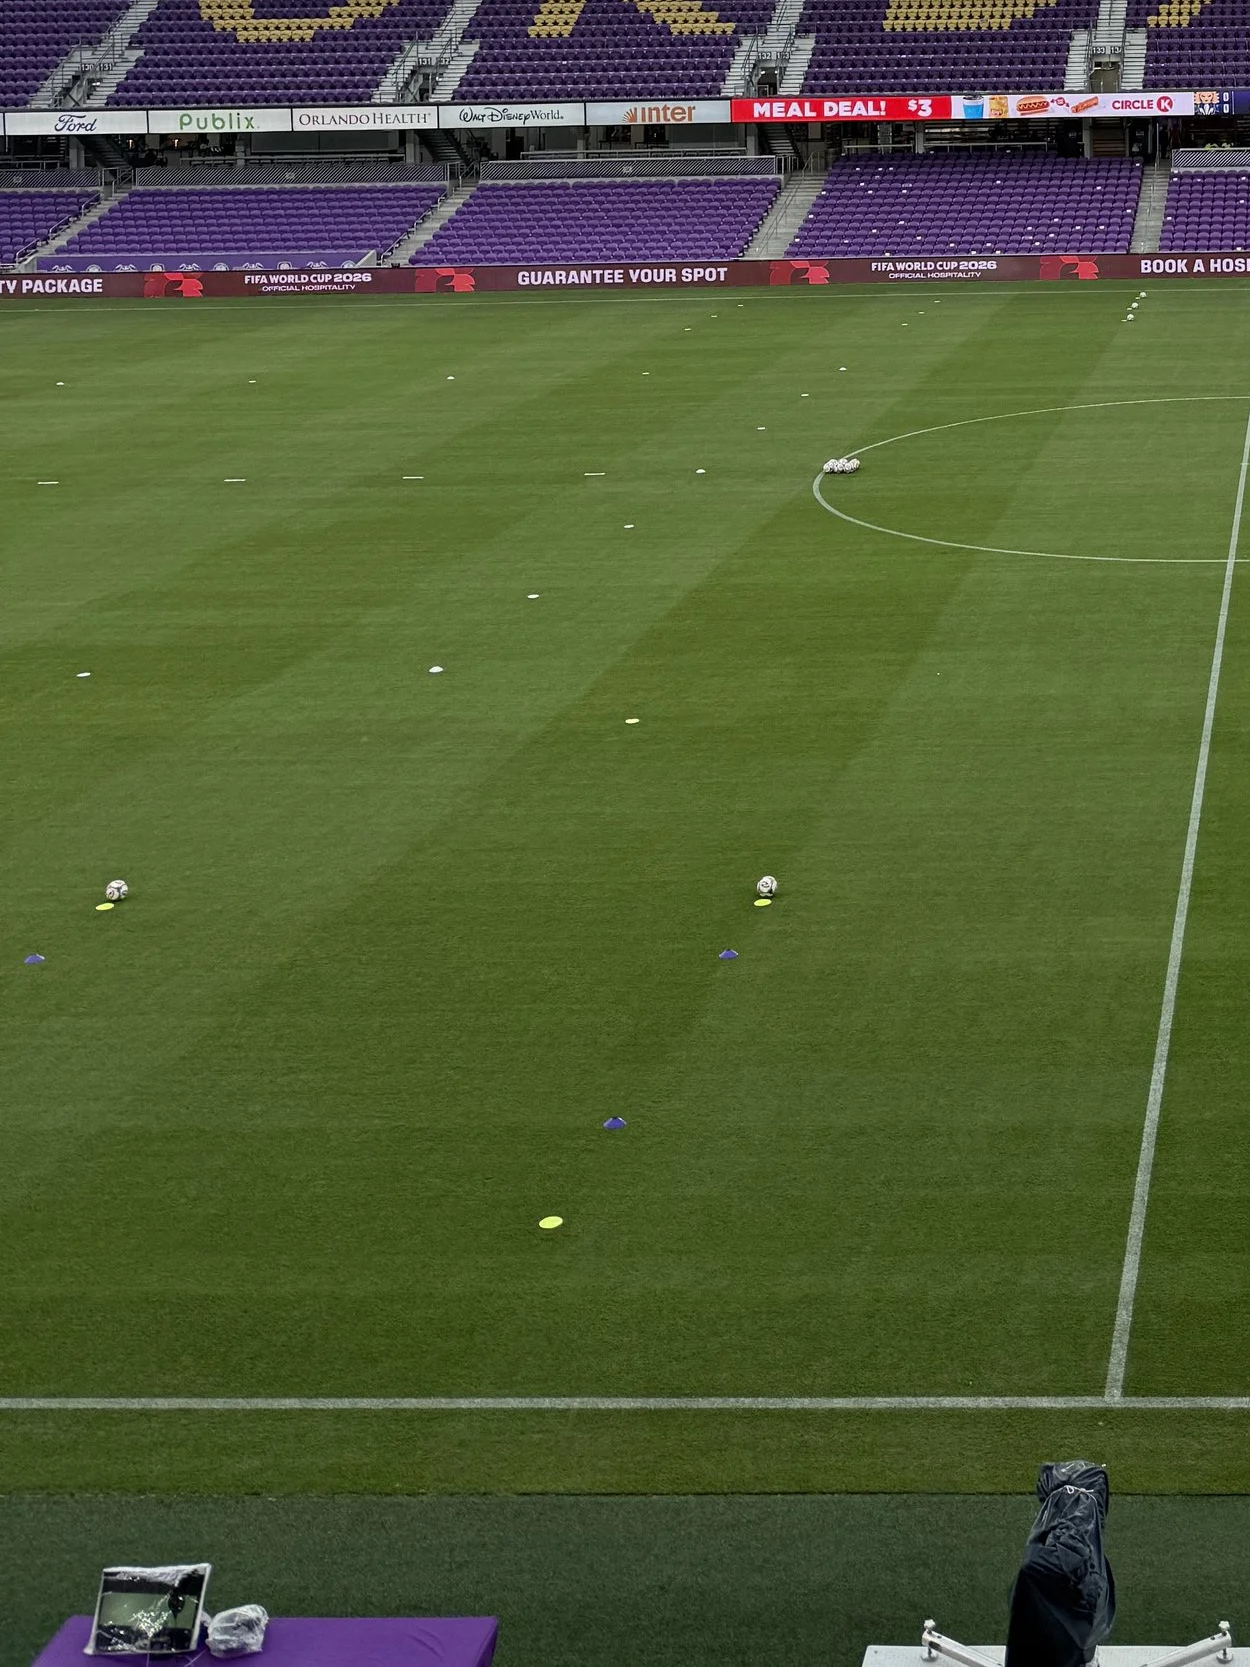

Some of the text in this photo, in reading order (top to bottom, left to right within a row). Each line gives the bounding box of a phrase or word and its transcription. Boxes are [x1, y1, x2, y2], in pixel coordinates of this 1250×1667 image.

[754, 99, 933, 118] MEAL DEAL! $3
[1112, 97, 1172, 111] CIRCLE K
[299, 112, 428, 126] ORLANDO HEALTH
[642, 104, 696, 123] inter
[54, 114, 97, 132] Ford
[179, 113, 255, 130] Publix
[871, 260, 997, 271] FIFA WORLD CUP 2026
[1140, 259, 1188, 274] BOOK
[1193, 259, 1205, 273] A
[244, 273, 372, 285] FIFA WORLD CUP 2026
[517, 267, 728, 285] GUARANTEE YOUR SPOT
[927, 271, 982, 279] HOSPITALITY
[22, 278, 103, 294] PACKAGE
[301, 284, 356, 292] HOSPITALITY
